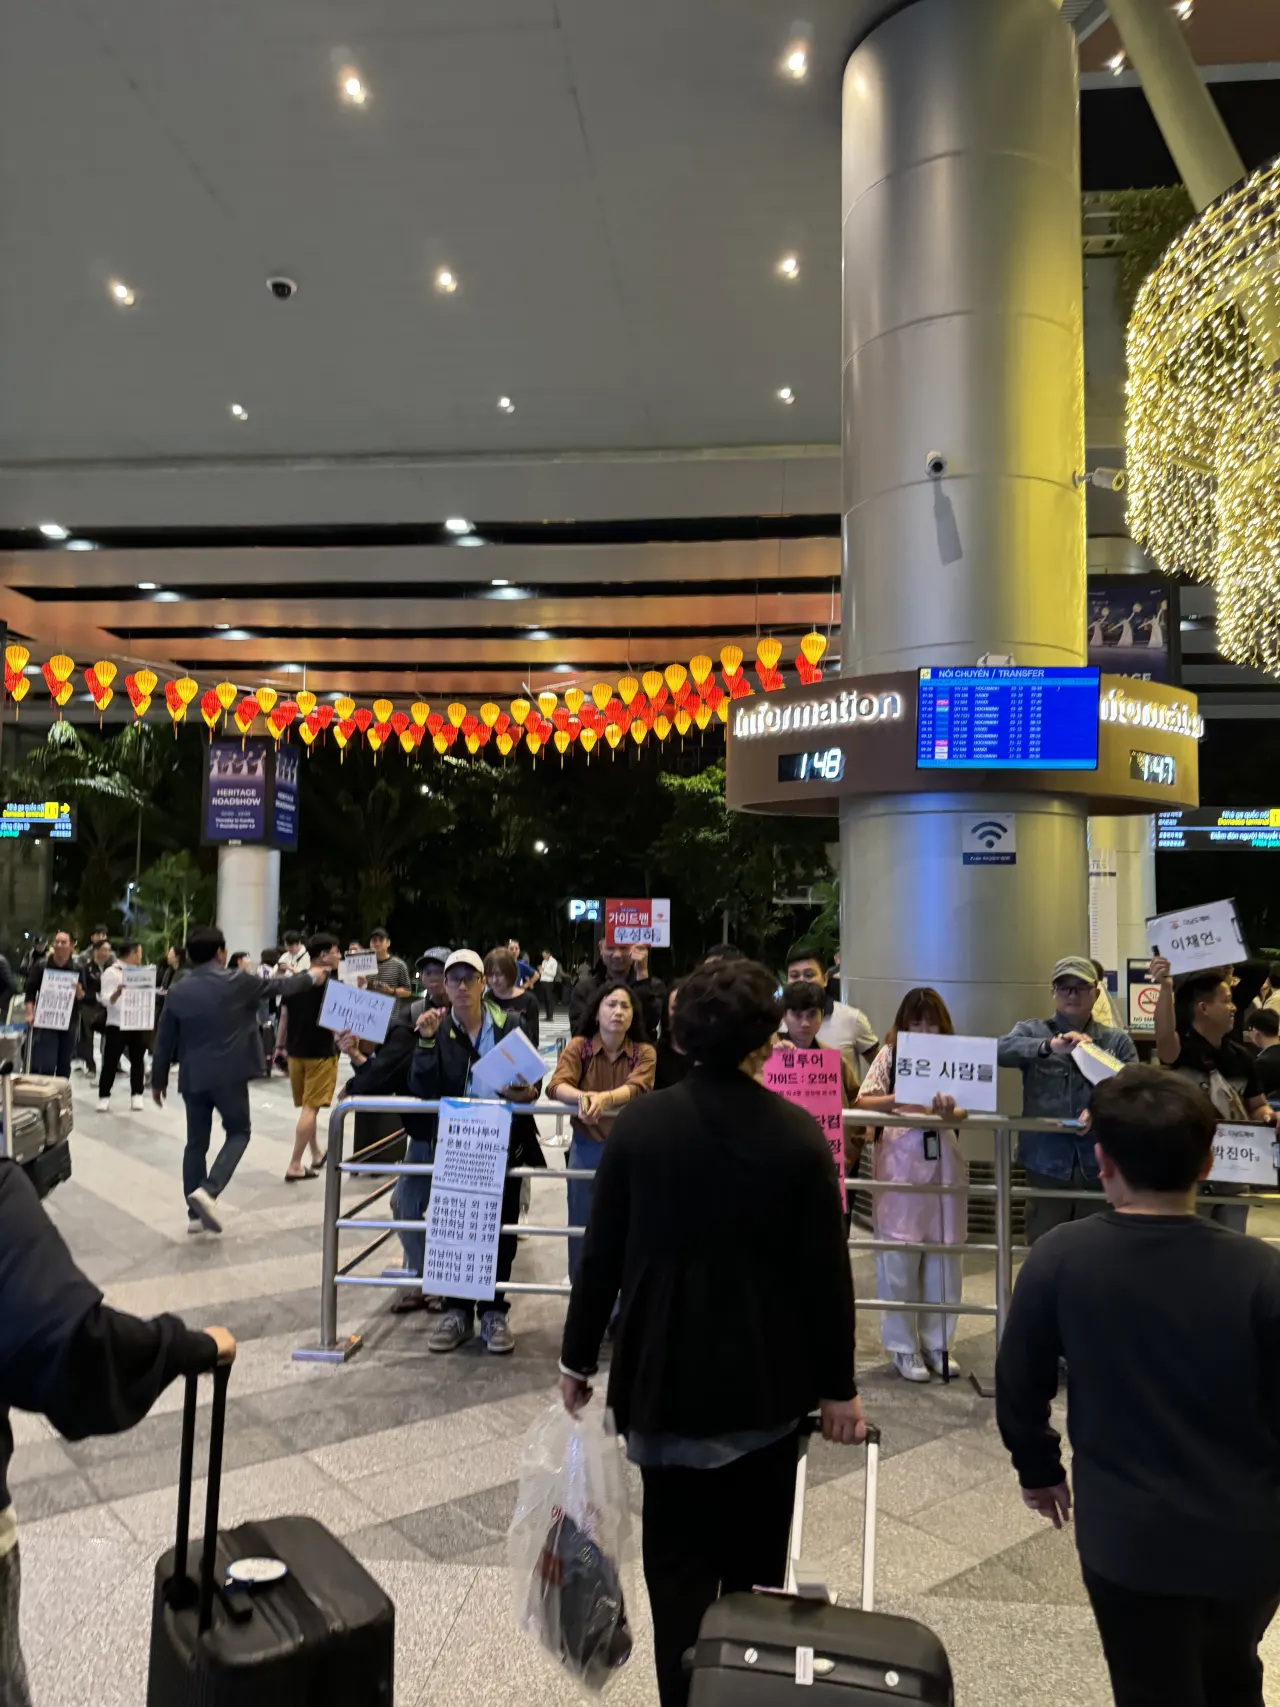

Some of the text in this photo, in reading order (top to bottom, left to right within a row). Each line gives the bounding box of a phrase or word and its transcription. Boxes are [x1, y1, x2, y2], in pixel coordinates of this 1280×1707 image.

[999, 669, 1045, 678] TRANSFER
[735, 692, 902, 737] Information
[217, 788, 256, 797] HERITAGE
[212, 797, 261, 806] ROADSHOW
[570, 899, 586, 921] P
[608, 912, 649, 926] 가이드맨
[782, 1053, 824, 1069] 웹투어
[897, 1057, 994, 1083] 좋은 사람들
[768, 1072, 798, 1085] 가이드
[462, 1126, 500, 1138] 하나투어
[475, 1140, 500, 1153] 가이드
